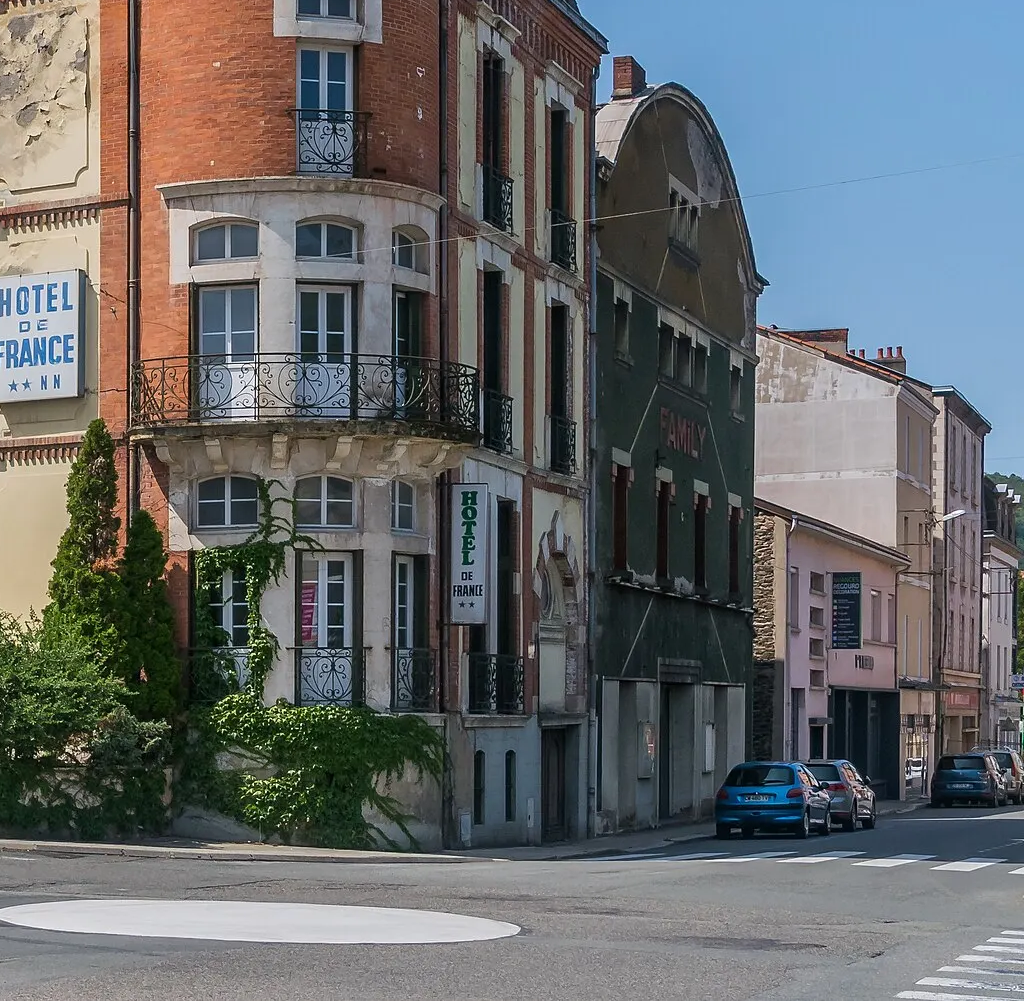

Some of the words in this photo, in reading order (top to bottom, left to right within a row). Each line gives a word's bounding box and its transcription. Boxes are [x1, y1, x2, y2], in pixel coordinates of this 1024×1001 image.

[19, 319, 48, 333] DE
[660, 407, 706, 461] FAMILY
[460, 490, 479, 566] HOTEL
[461, 571, 473, 581] DE
[453, 584, 483, 597] FRANCE
